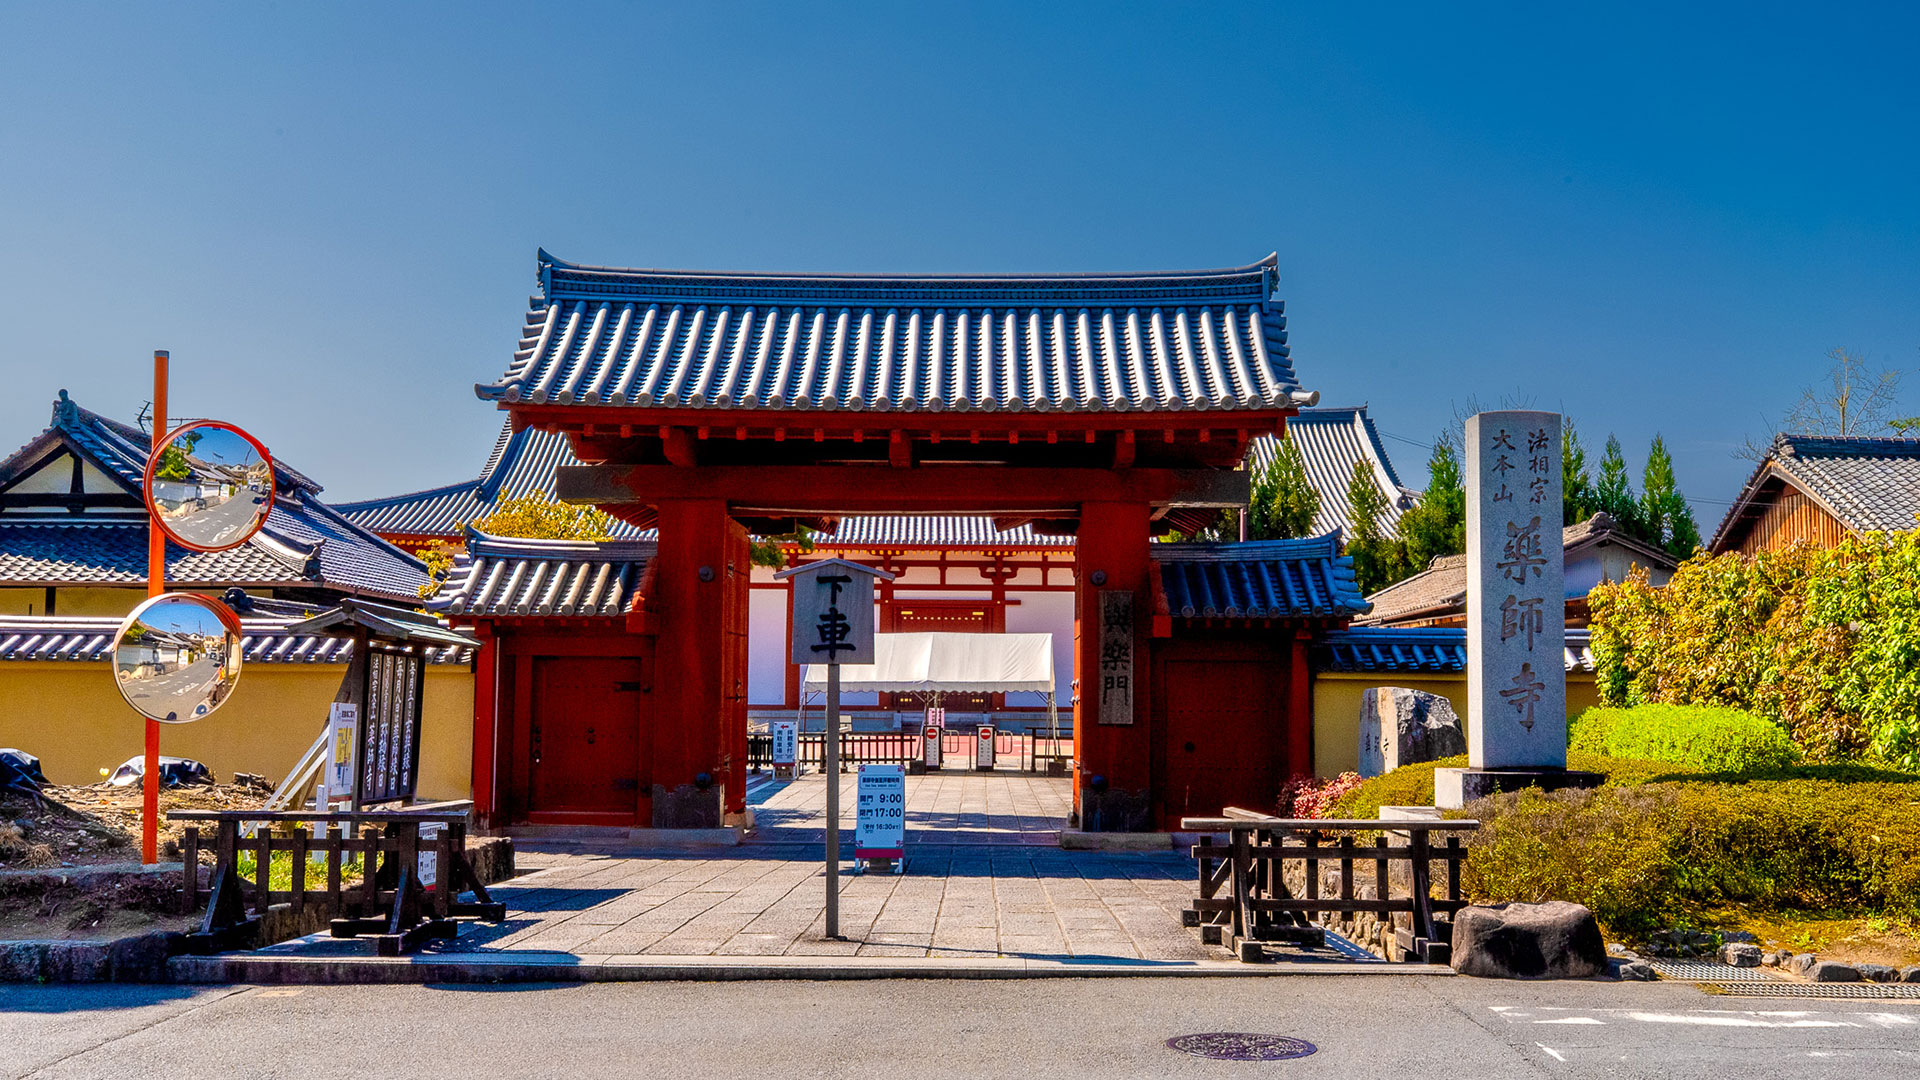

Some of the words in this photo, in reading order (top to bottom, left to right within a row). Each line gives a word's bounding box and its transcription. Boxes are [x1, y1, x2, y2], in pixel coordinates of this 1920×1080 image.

[1492, 429, 1516, 502] 大本山
[1528, 429, 1549, 504] 法相宗
[811, 575, 856, 660] 下車
[874, 807, 902, 818] 17:00
[879, 793, 902, 803] 9:00
